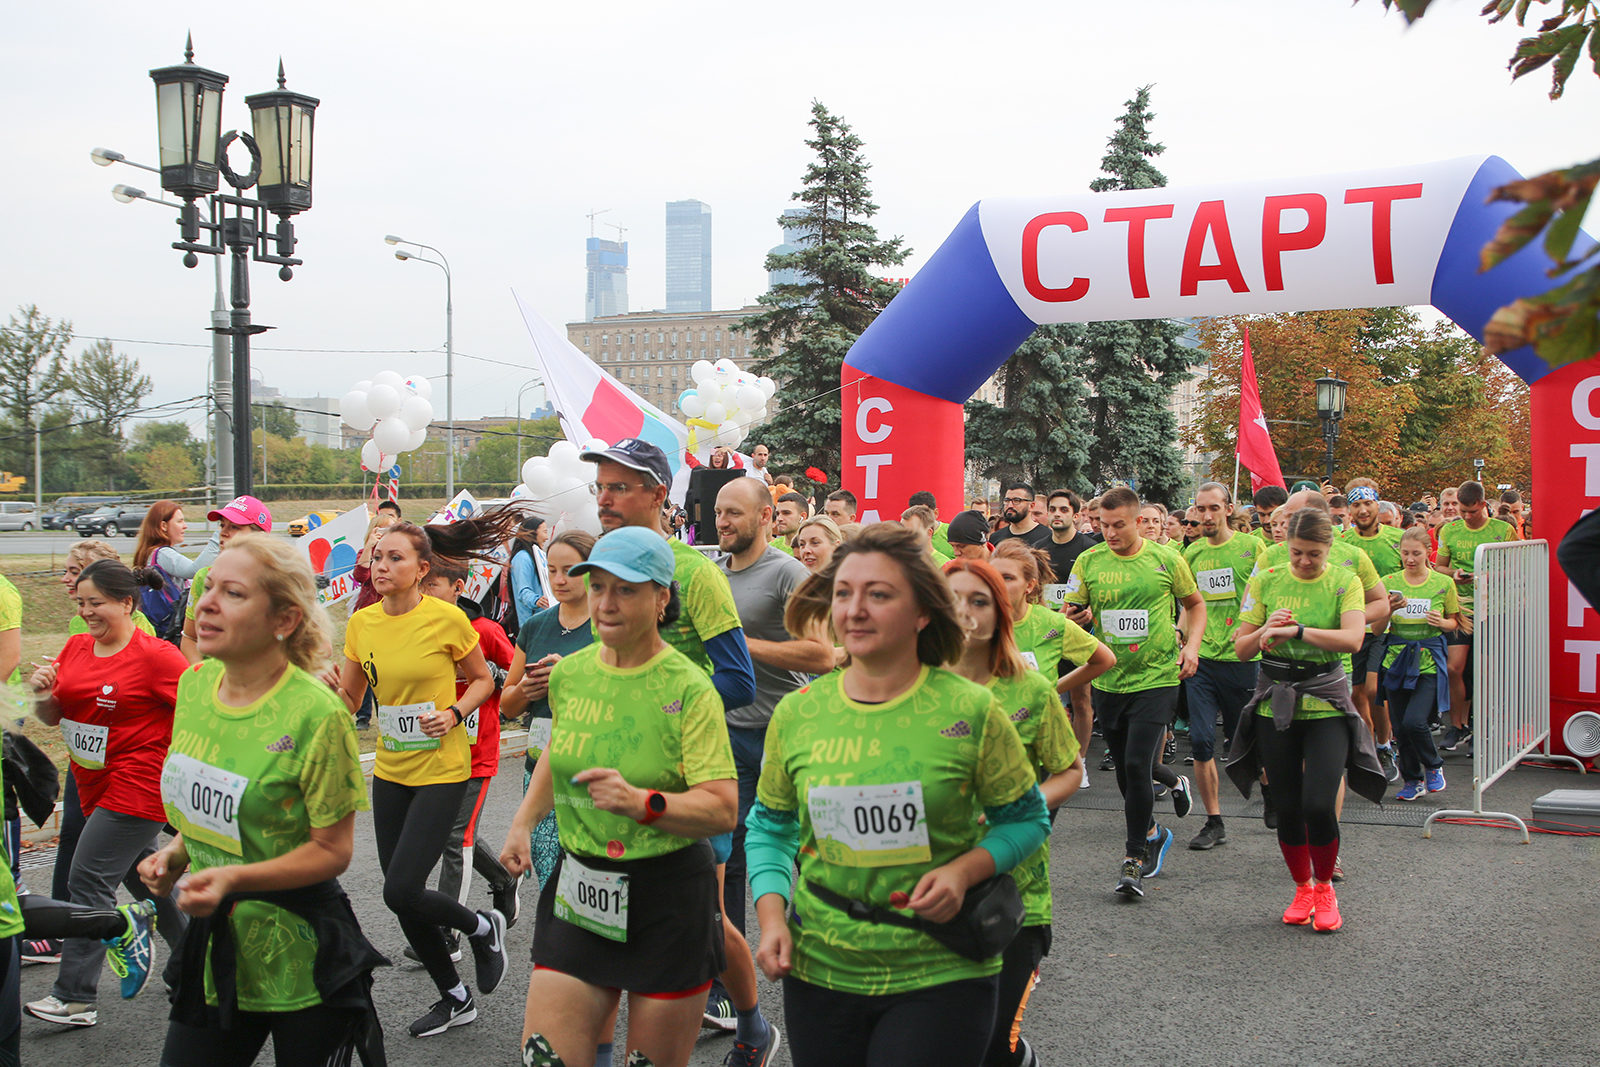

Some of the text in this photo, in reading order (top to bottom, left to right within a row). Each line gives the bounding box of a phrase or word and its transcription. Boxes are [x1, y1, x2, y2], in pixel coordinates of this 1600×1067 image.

[1022, 183, 1423, 303] СТАРТ
[1099, 572, 1122, 584] RUN
[1209, 575, 1231, 588] 0437
[1099, 589, 1120, 602] EAT
[1275, 595, 1301, 609] RUN
[1406, 604, 1427, 614] 0206
[1119, 618, 1145, 631] 0780
[563, 697, 615, 725] RUN &
[74, 732, 103, 754] 0627
[173, 730, 220, 764] RUN &
[552, 730, 592, 758] EAT
[808, 736, 881, 765] RUN &
[191, 782, 233, 823] 0070
[854, 803, 917, 835] 0069
[578, 881, 620, 915] 0801
